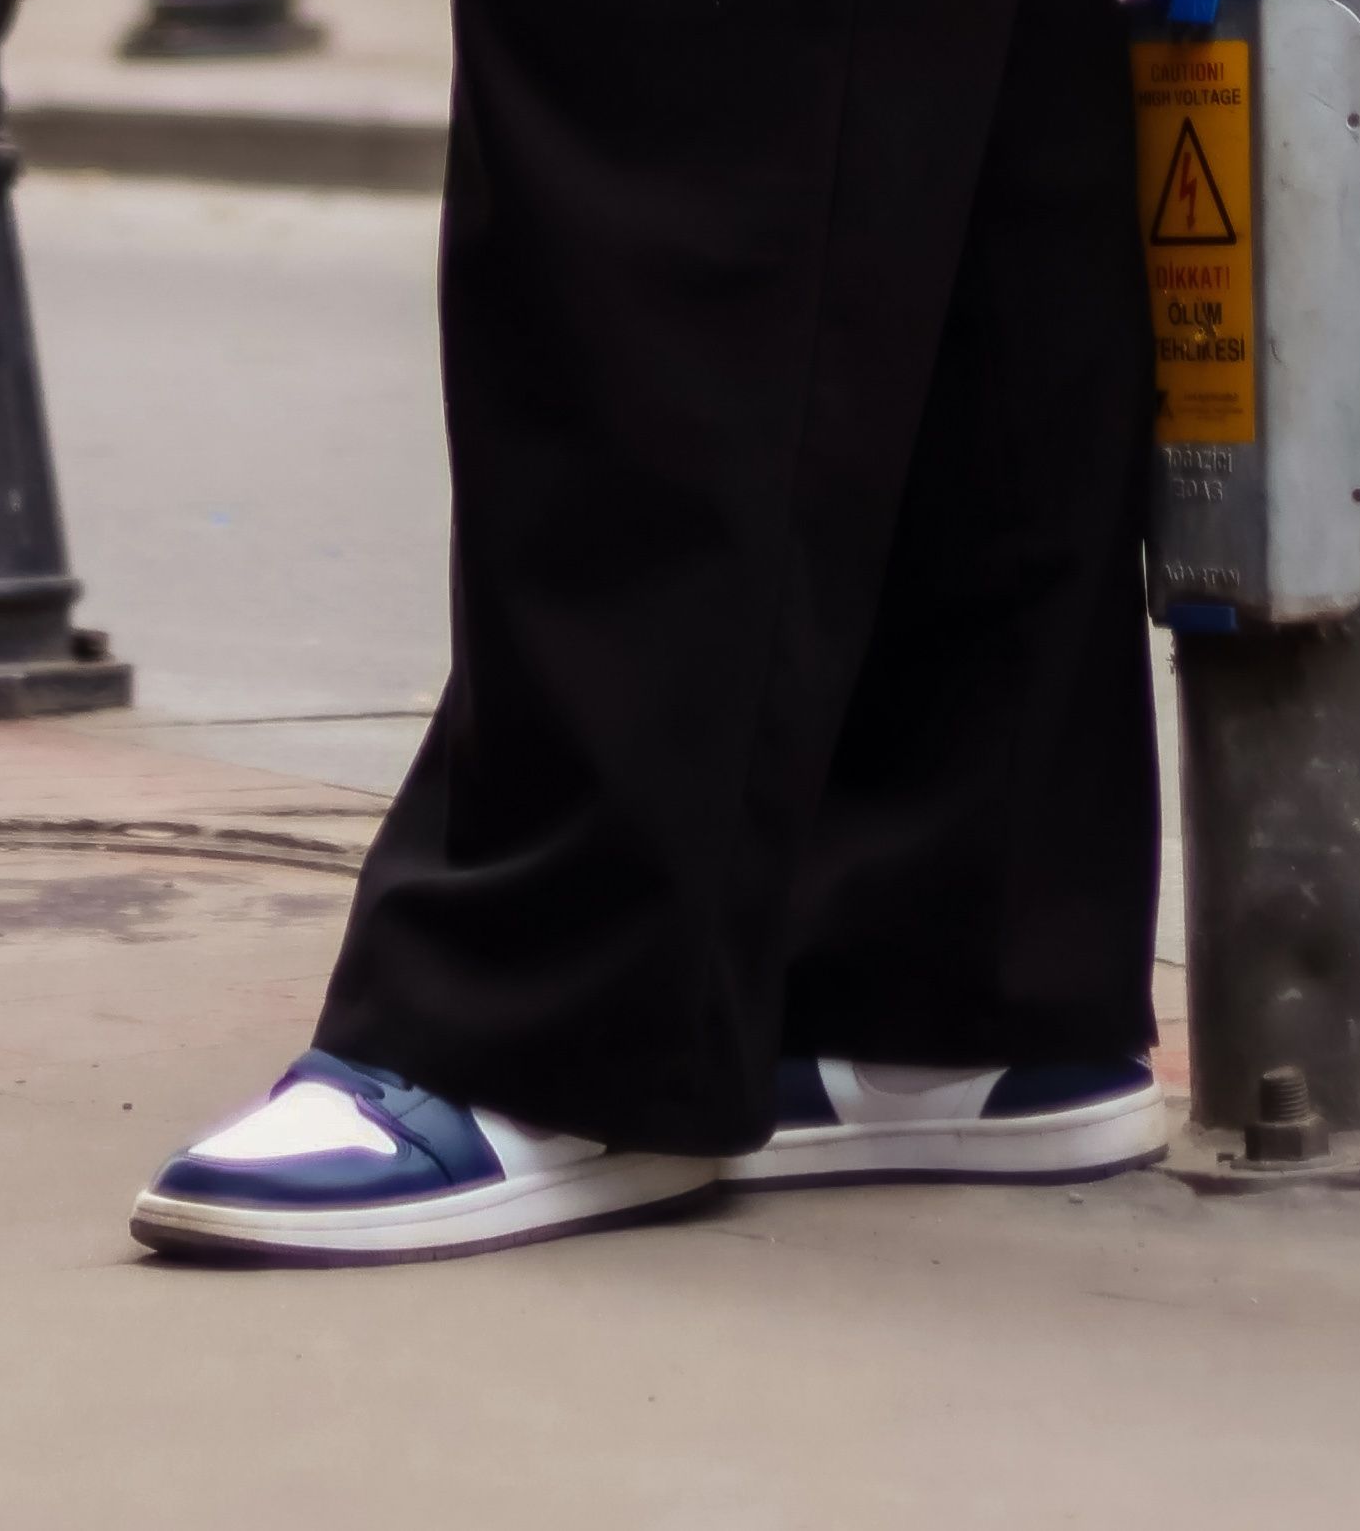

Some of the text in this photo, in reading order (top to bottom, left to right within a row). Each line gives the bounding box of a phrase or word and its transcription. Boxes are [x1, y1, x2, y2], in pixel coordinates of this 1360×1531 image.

[1150, 62, 1225, 83] CAUTION!
[1138, 88, 1242, 108] HIGH VOLTAGE
[1155, 260, 1231, 290] DİKKAT!
